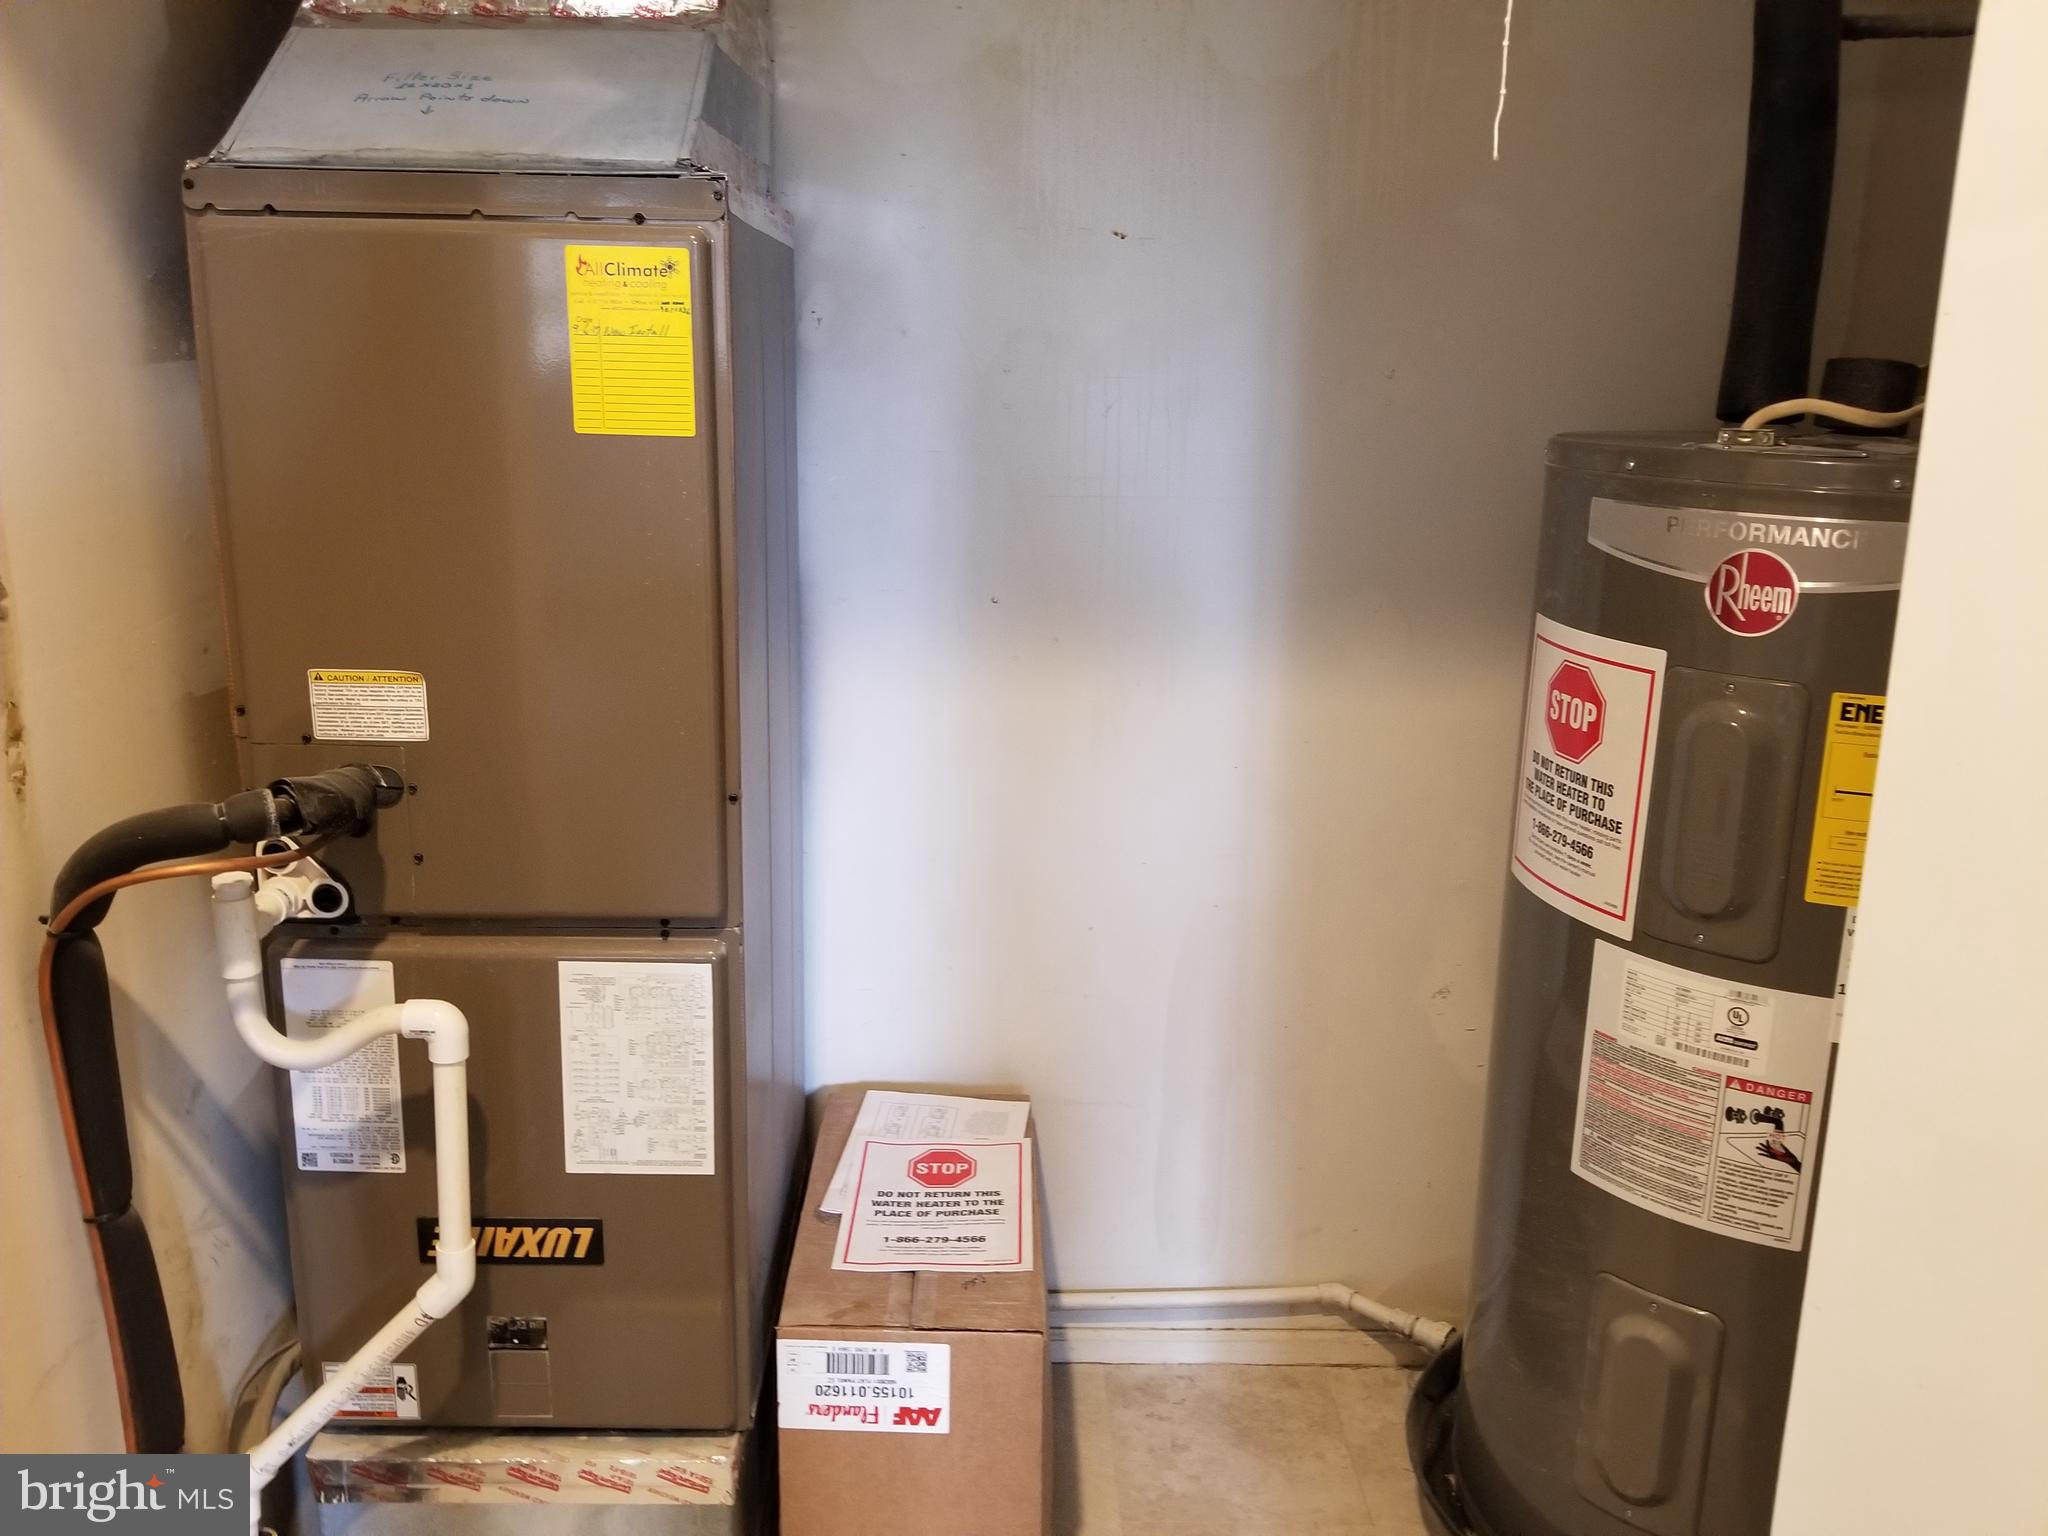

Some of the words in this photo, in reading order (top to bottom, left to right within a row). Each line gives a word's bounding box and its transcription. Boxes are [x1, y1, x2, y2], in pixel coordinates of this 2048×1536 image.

[353, 93, 408, 103] Arrow
[419, 92, 475, 102] Points
[480, 94, 530, 104] down
[1715, 551, 1793, 622] Rheem
[327, 674, 364, 682] CAUTION
[372, 675, 419, 683] ATTENTION
[1550, 689, 1597, 732] STOP
[1532, 750, 1541, 765] DO
[1540, 755, 1554, 773] NOT
[1554, 763, 1589, 789] RETURN
[1590, 777, 1615, 797] THIS
[1534, 767, 1555, 790] WATER
[1556, 780, 1589, 806] HEATER
[1592, 795, 1606, 812] TO
[1525, 777, 1535, 794] THE
[1534, 785, 1555, 807] PLACE
[1556, 797, 1568, 812] OF
[1568, 803, 1622, 835] PURCHASE
[1532, 817, 1594, 859] 1-866-279-4566
[1745, 1083, 1806, 1102] DANGER
[916, 1163, 969, 1174] STOP
[872, 1200, 912, 1208] WATER
[916, 1200, 962, 1208] HEATER
[965, 1199, 980, 1207] TO
[877, 1190, 893, 1198] DO
[874, 1209, 912, 1217] PLACE
[935, 1209, 1000, 1217] PURCHASE
[883, 1235, 987, 1244] 1-866-279-4566
[815, 1384, 915, 1399] 10155.011620
[807, 1403, 879, 1425] Flanders
[893, 1406, 943, 1426] AAF
